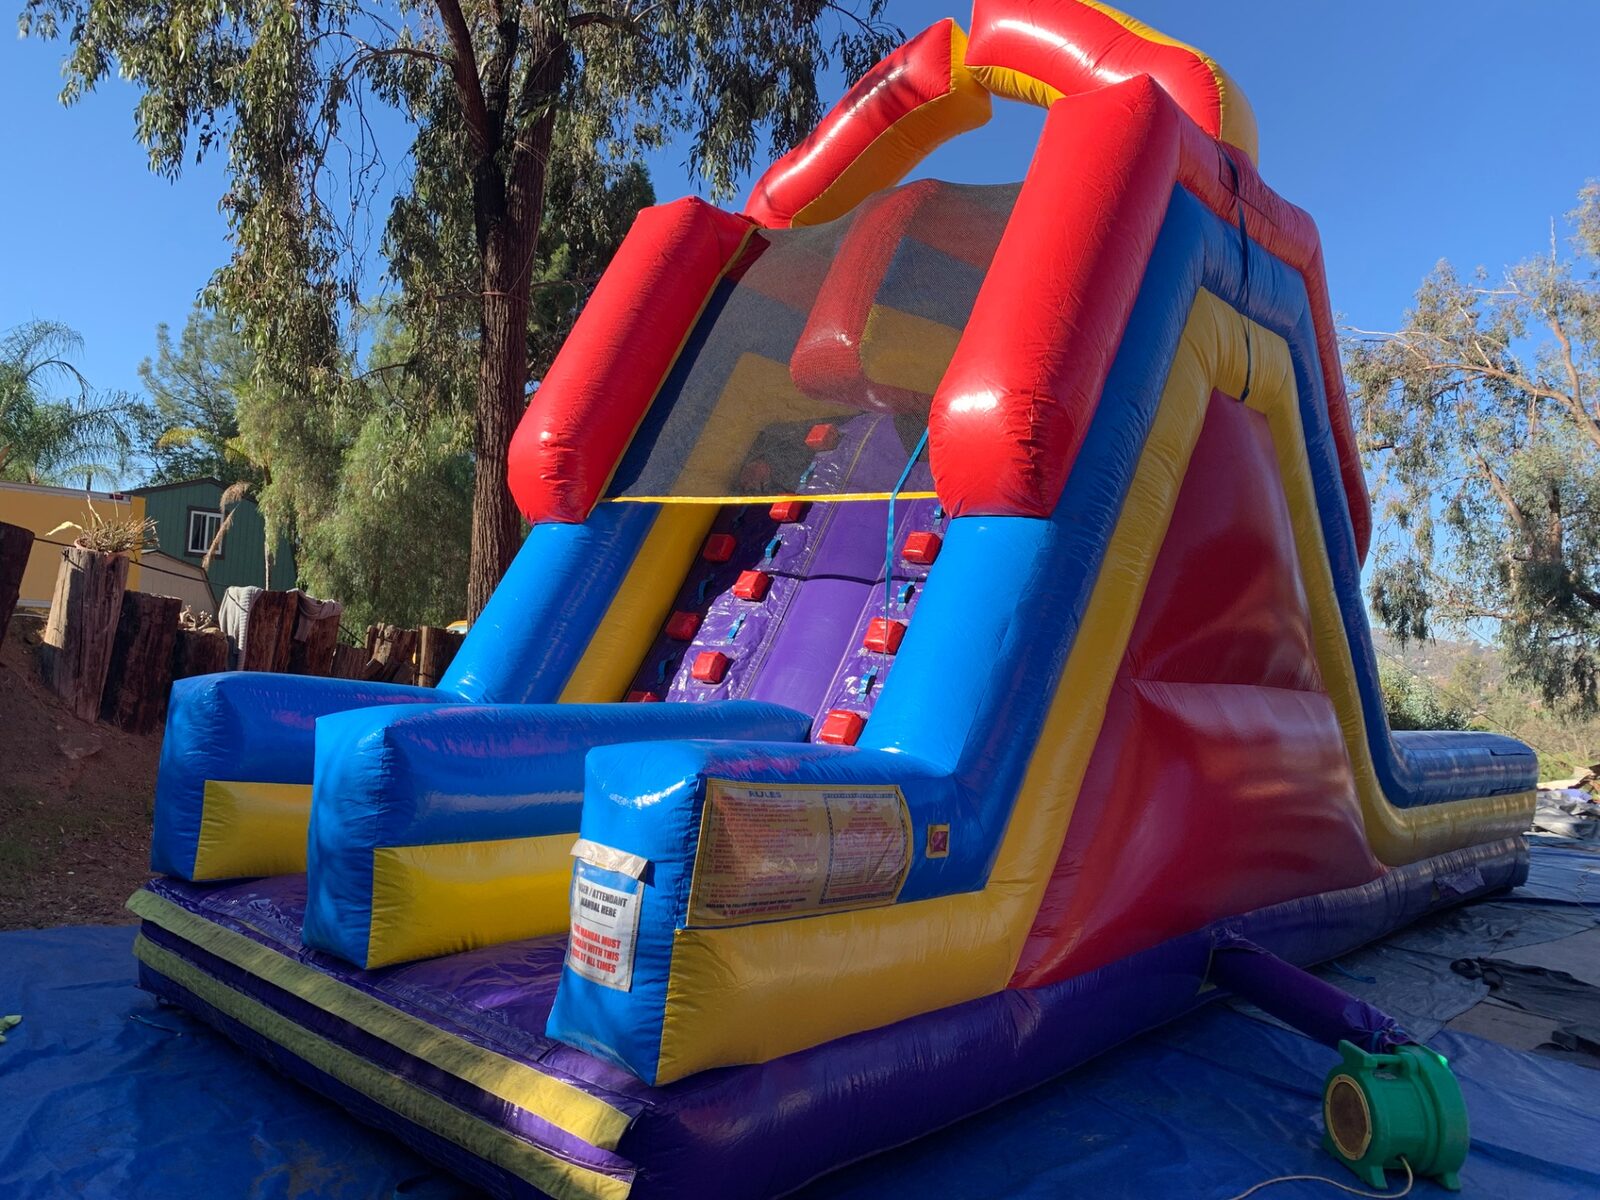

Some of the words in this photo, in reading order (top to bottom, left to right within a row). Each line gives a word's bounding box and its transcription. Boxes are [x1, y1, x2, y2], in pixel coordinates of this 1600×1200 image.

[748, 790, 782, 798] RULES
[580, 896, 600, 912] MANUAL
[601, 905, 617, 917] HERE
[592, 889, 628, 907] ATTENDANT
[580, 927, 601, 943] MANUAL
[601, 935, 621, 949] MUST
[587, 943, 603, 957] WITH
[604, 949, 619, 961] THIS
[586, 956, 595, 967] ALL
[597, 959, 616, 974] TIMES
